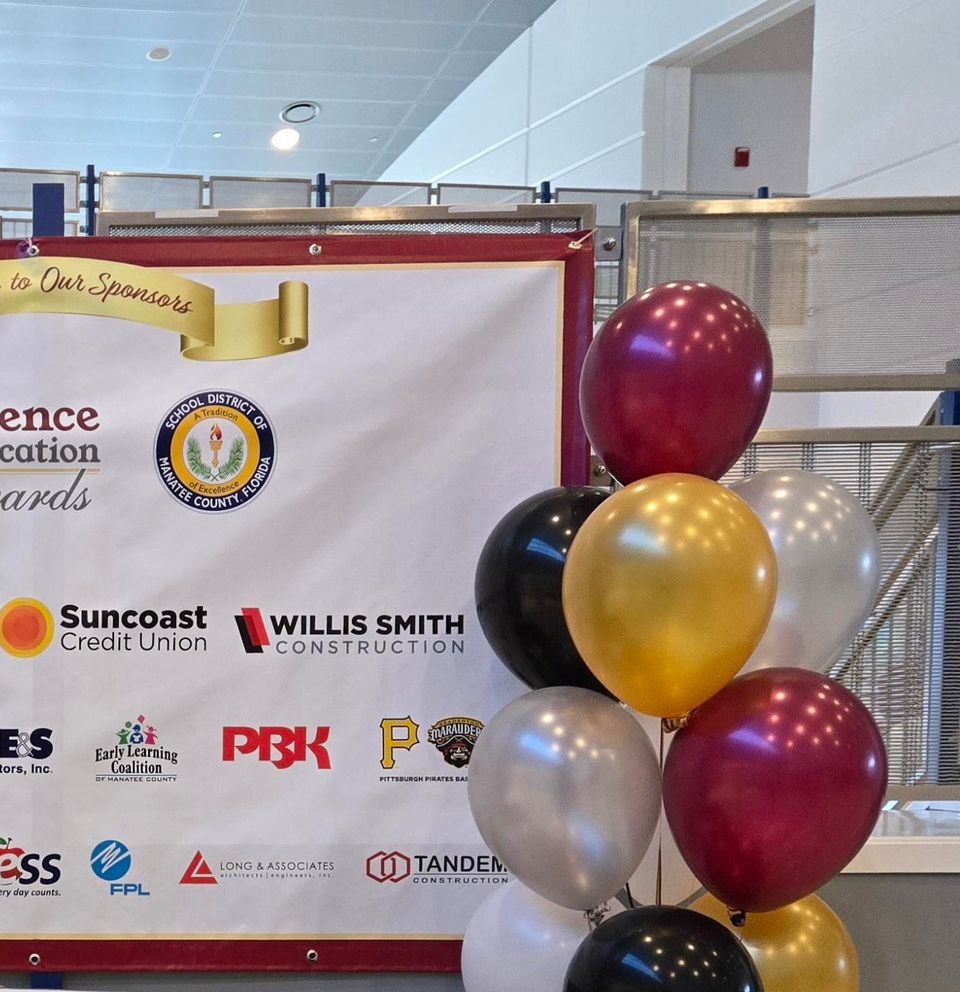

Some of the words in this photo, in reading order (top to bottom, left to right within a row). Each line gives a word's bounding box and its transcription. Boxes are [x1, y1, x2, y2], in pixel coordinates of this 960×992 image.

[10, 271, 32, 291] to
[40, 266, 86, 293] Our
[88, 272, 194, 314] Sponsors
[165, 397, 205, 431] SCHOOL
[207, 393, 256, 416] DISTRICT
[253, 415, 268, 431] OF
[201, 408, 239, 421] Tradition
[159, 456, 193, 502] MANATEE
[243, 456, 271, 498] FLORIDA
[189, 481, 199, 490] of
[198, 481, 239, 494] Excellence
[59, 604, 208, 630] Suncoast
[270, 615, 368, 636] WILLIS
[375, 614, 465, 635] SMITH
[60, 632, 132, 652] Credit
[139, 632, 207, 652] Union
[275, 639, 465, 655] CONSTRUCTION
[431, 723, 480, 741] MARAUDER
[222, 726, 331, 770] PBK
[380, 715, 420, 769] P
[95, 745, 125, 762] Early
[127, 744, 178, 765] Learning
[31, 763, 53, 774] Inc.
[111, 760, 162, 774] Coalition
[220, 862, 253, 871] LONG
[257, 862, 264, 871] &
[267, 862, 335, 871] ASSOCIATES
[414, 855, 508, 872] TANDEM
[13, 888, 29, 897] day
[110, 884, 150, 895] FPL
